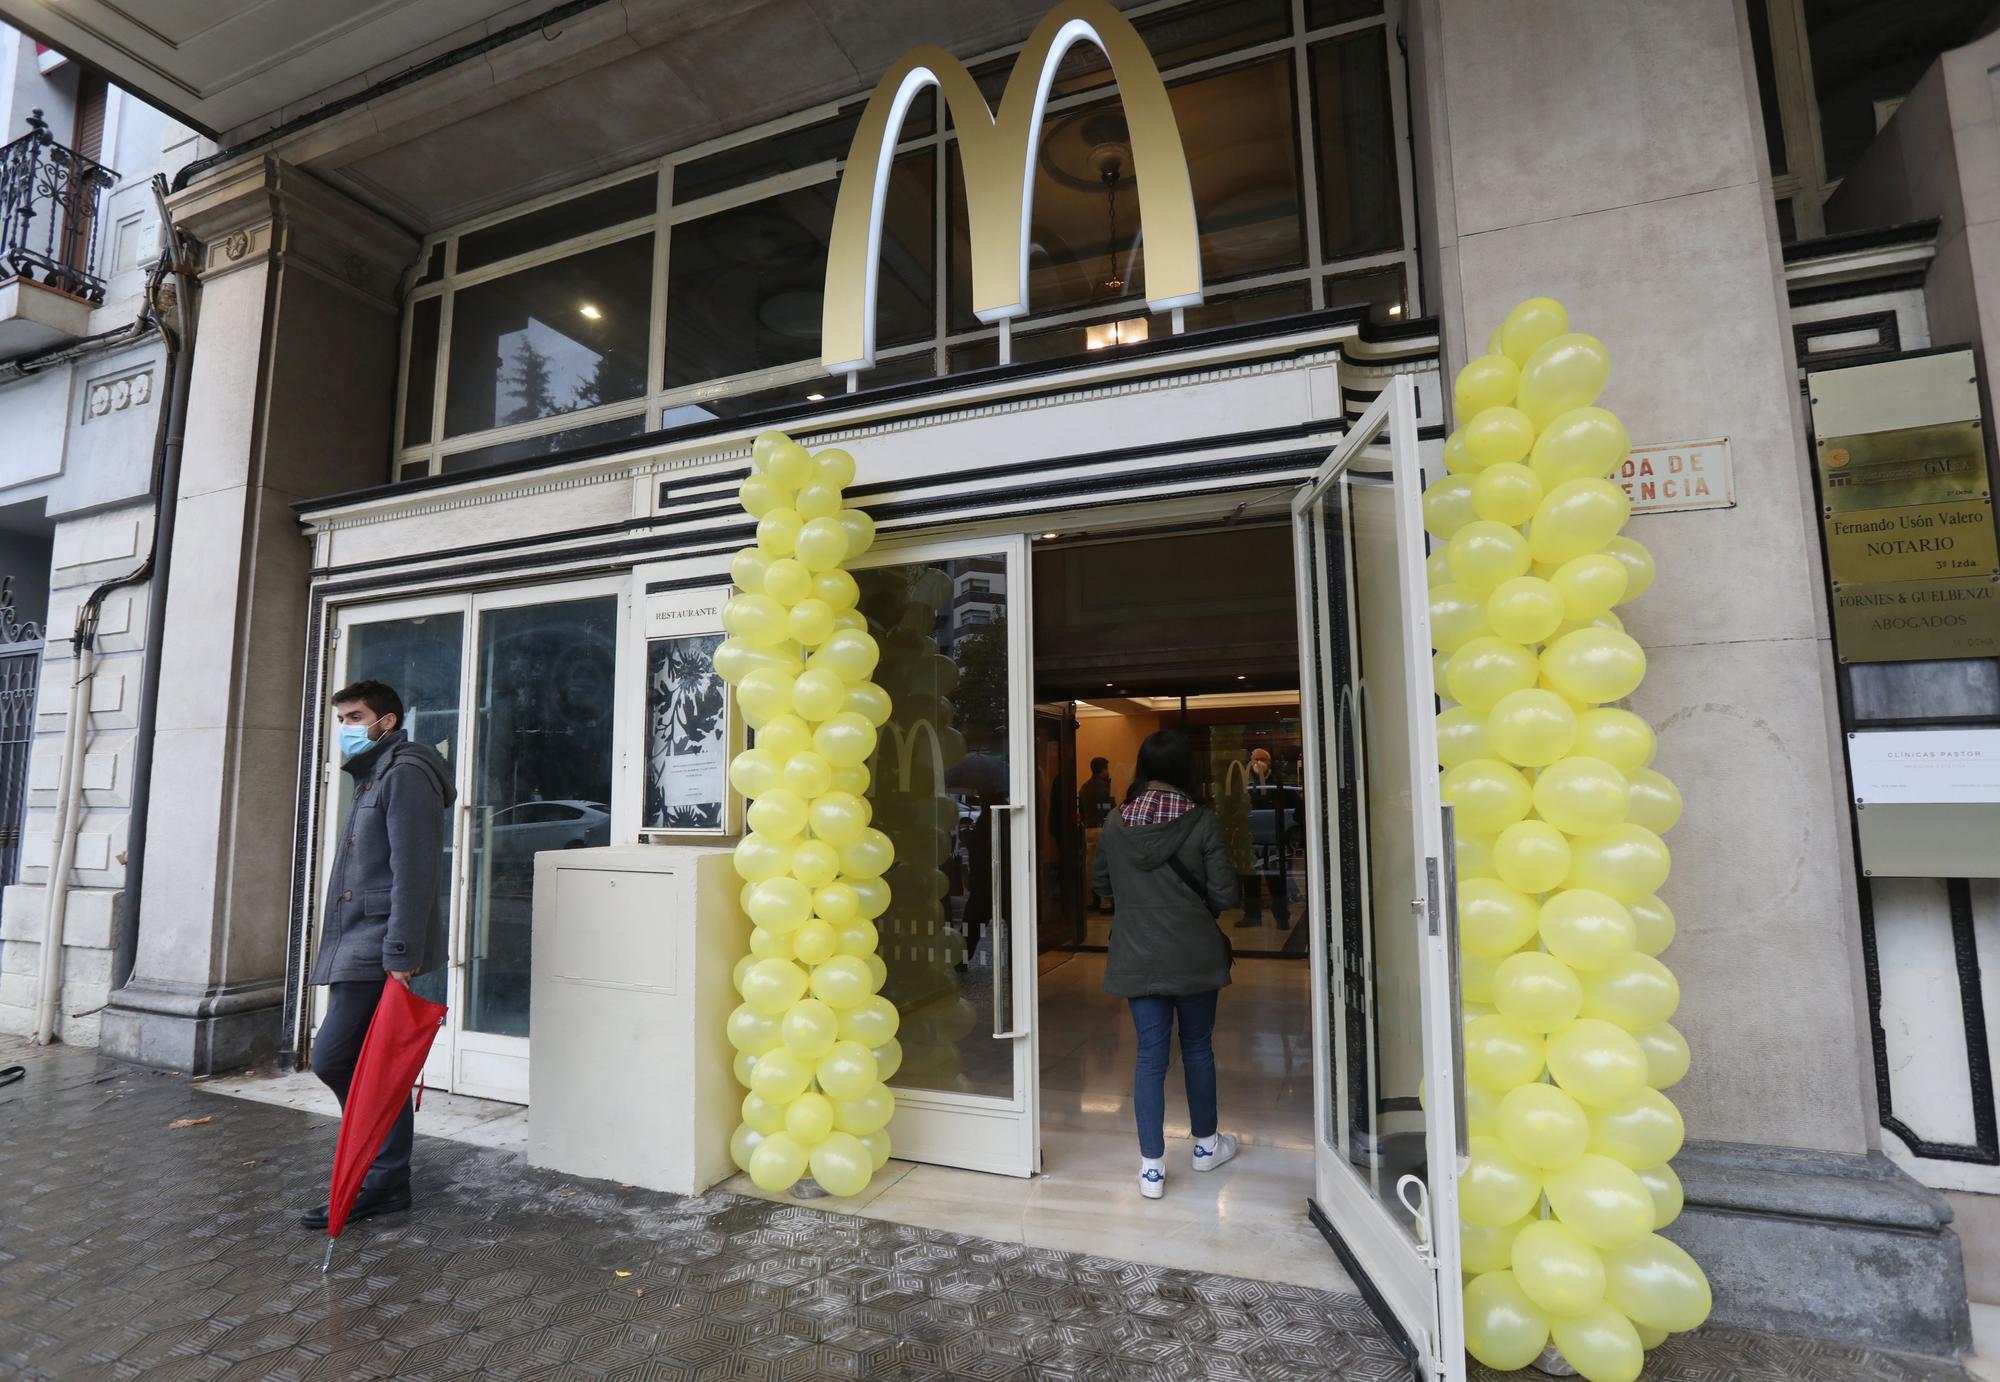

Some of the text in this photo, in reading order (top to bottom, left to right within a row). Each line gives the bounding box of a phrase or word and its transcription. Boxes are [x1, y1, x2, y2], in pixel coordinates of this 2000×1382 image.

[1611, 453, 1705, 479] DA DE
[1620, 477, 1711, 502] ENCIA
[1834, 511, 1984, 535] Fernando Usón Valero
[1866, 536, 1954, 556] NOTARIO
[1839, 587, 1994, 607] FORNIES & GUELBENZU
[655, 607, 718, 620] RESTAURANTE
[1871, 614, 1968, 630] ABOGADOS
